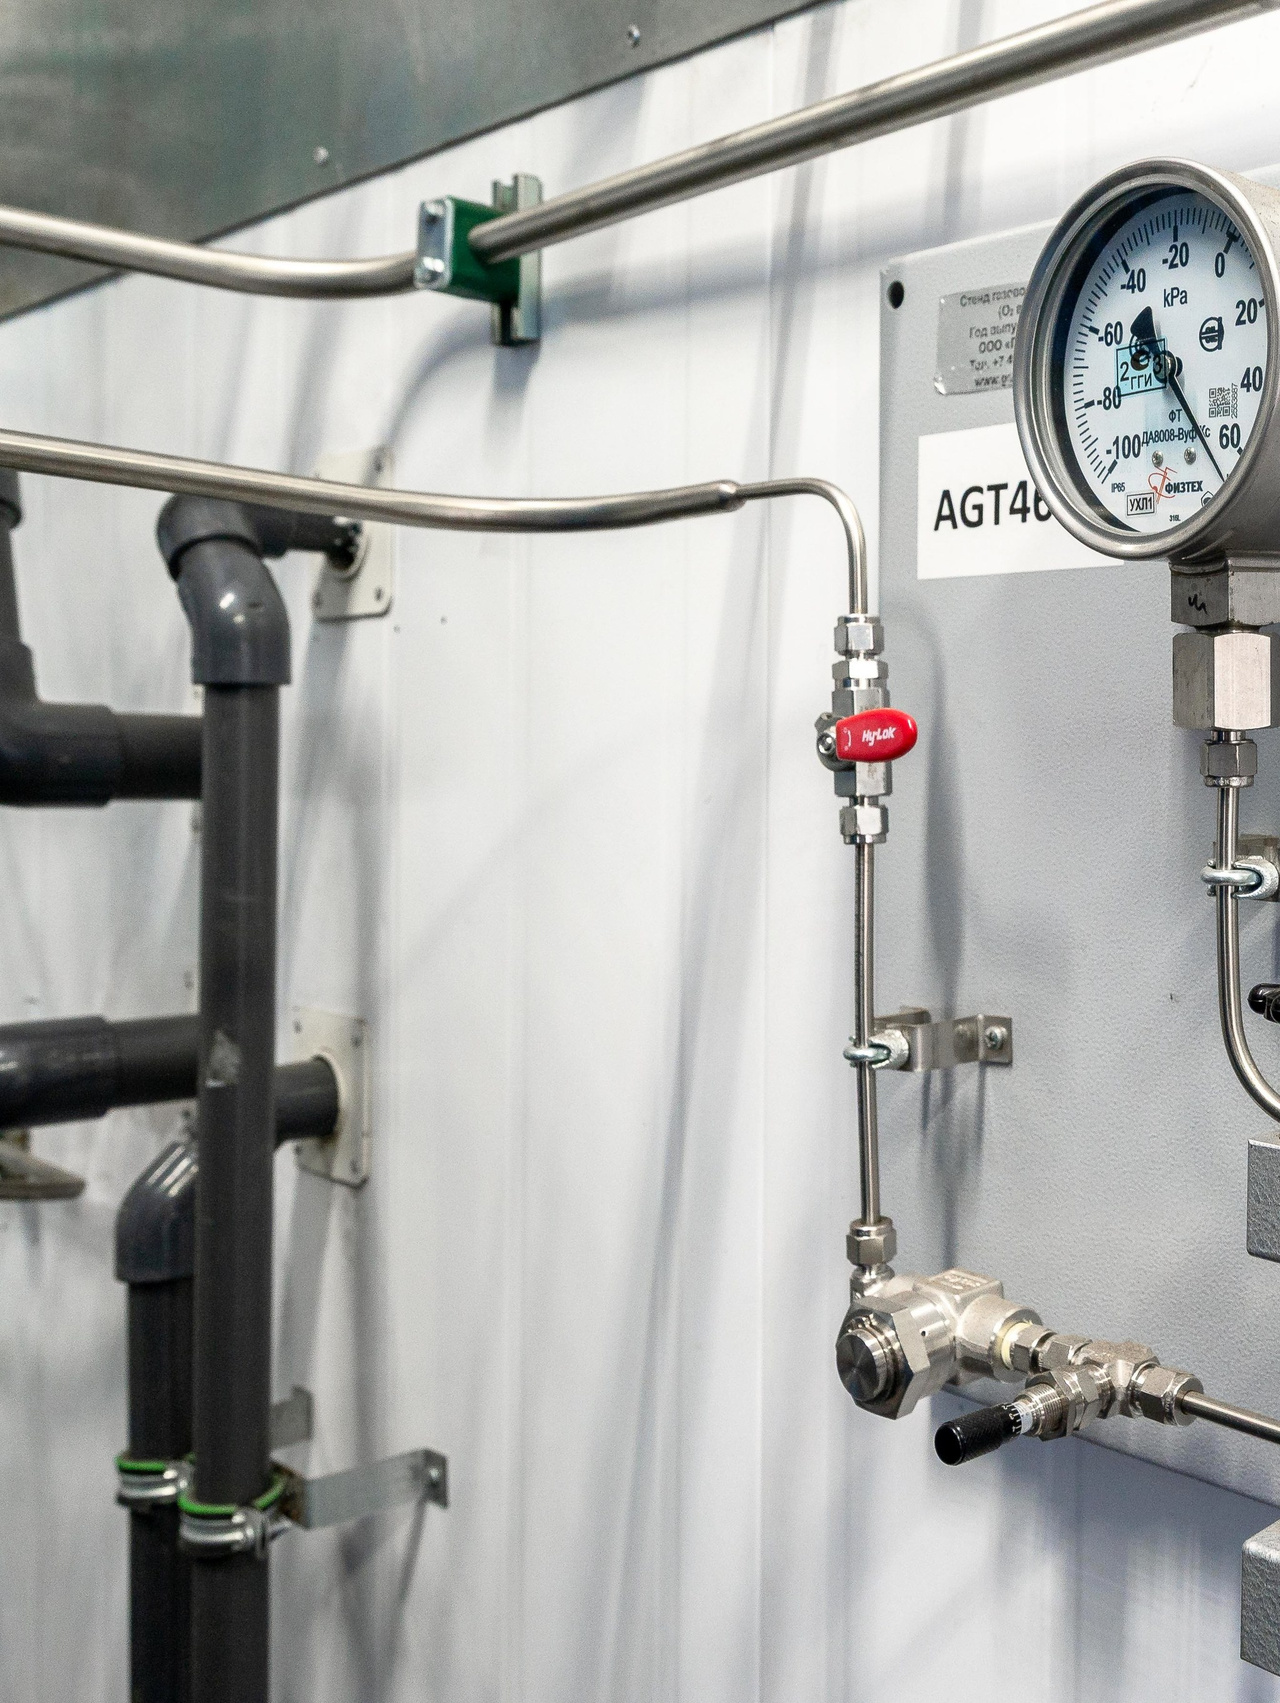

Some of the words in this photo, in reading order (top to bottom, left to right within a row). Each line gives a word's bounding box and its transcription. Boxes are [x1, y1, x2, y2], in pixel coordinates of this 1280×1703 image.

[1161, 241, 1190, 270] -20
[1214, 252, 1226, 278] 0
[1120, 267, 1147, 294] -40
[1163, 286, 1188, 308] kPa
[1235, 297, 1258, 326] 20
[1098, 320, 1123, 347] -60
[1131, 373, 1152, 390] ГГИ
[1240, 365, 1263, 393] 40
[1096, 385, 1122, 411] -80
[1168, 408, 1183, 424] ФТ
[1106, 434, 1141, 459] -100
[1219, 422, 1241, 450] 60
[1111, 482, 1126, 493] IP65
[1165, 480, 1203, 494] ФИЗТЕХ
[1129, 497, 1153, 512] УХЛ1
